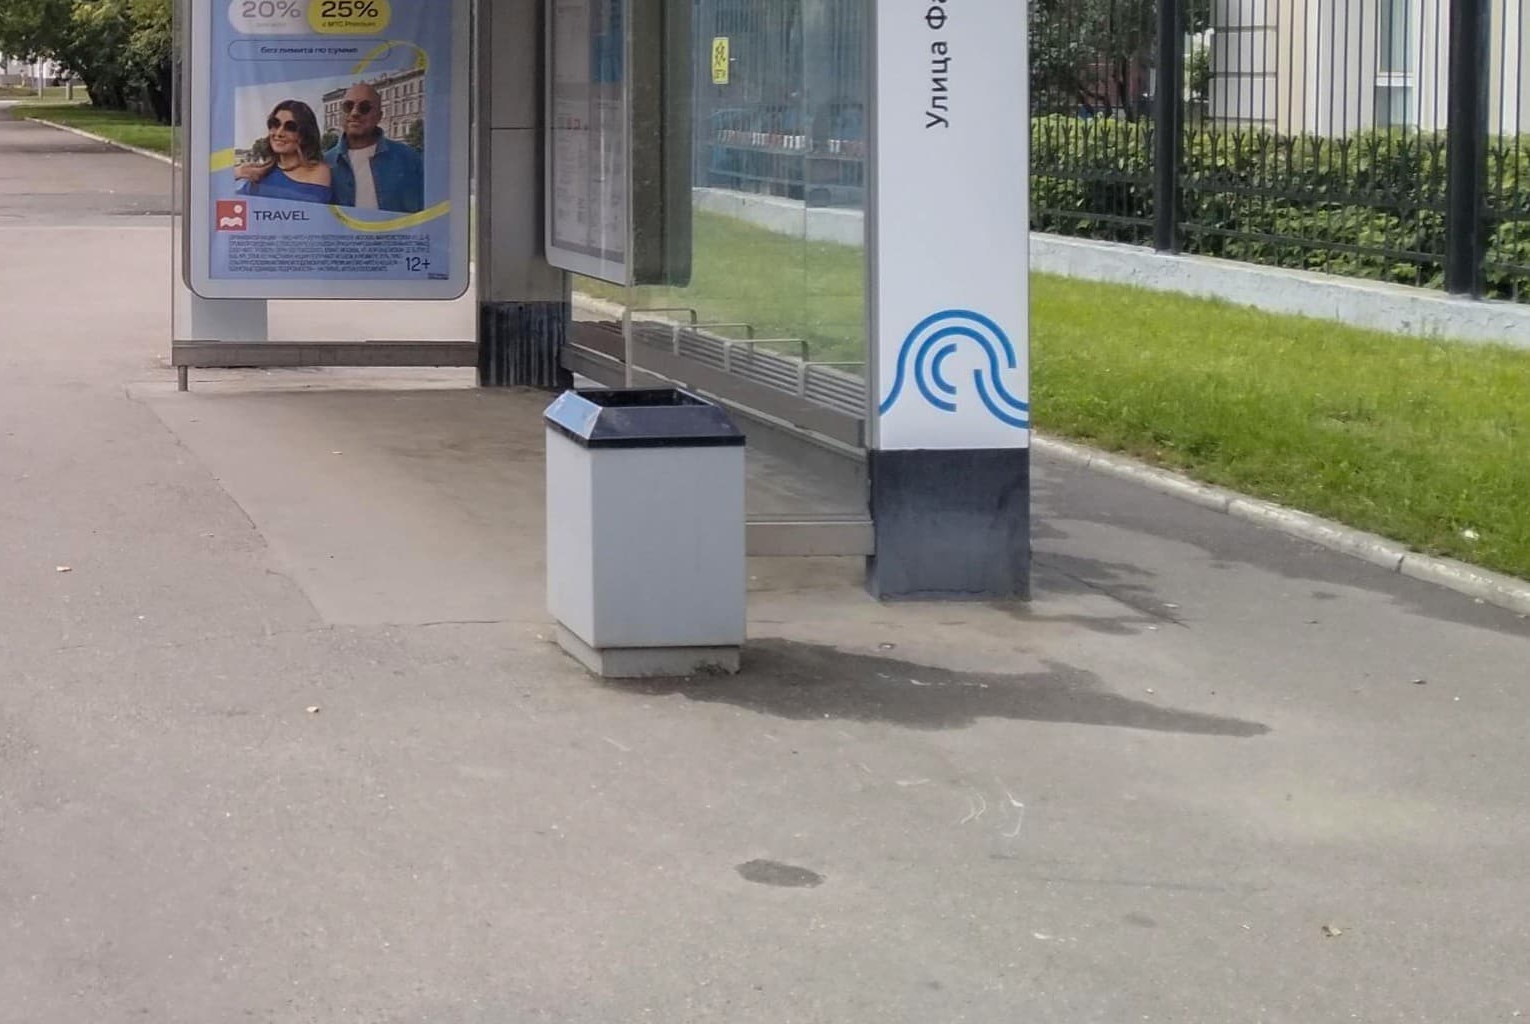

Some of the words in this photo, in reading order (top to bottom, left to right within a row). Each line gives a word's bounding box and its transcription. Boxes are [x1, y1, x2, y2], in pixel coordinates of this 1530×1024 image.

[242, 0, 301, 18] 20%
[321, 0, 379, 18] 25%
[925, 41, 952, 128] Улица
[254, 210, 310, 221] TRAVEL
[406, 257, 431, 271] 12+
